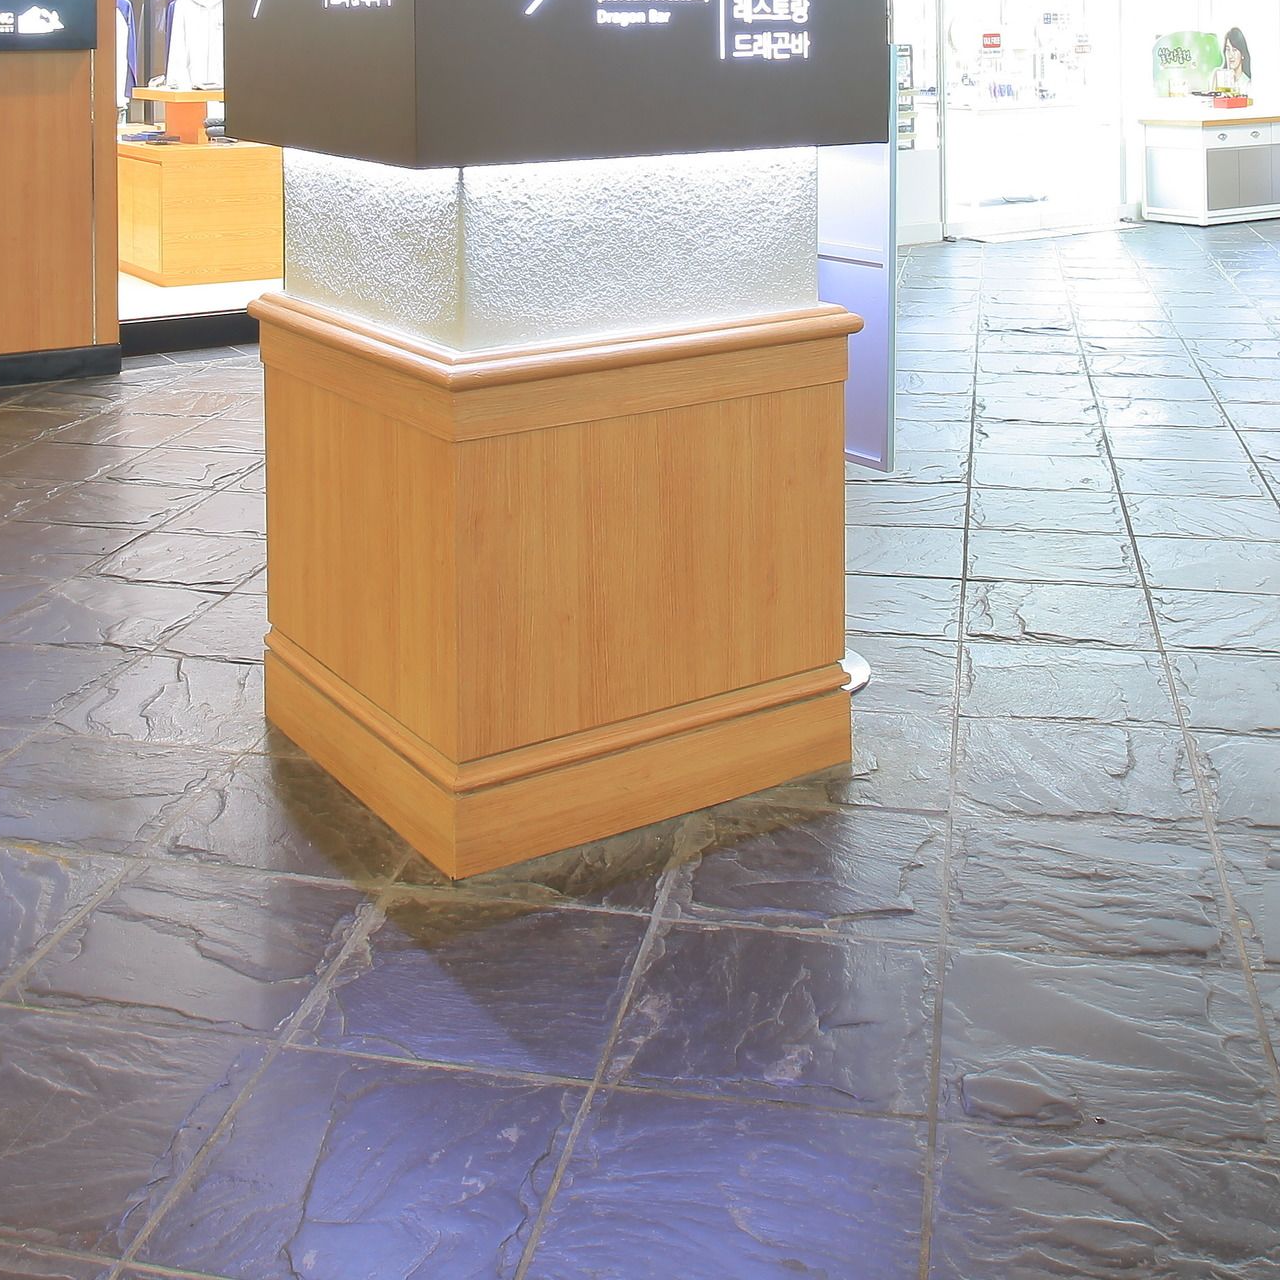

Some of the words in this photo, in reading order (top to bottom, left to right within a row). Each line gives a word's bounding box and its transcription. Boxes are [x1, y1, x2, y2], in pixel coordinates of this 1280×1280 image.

[596, 9, 646, 27] Dragon
[648, 9, 671, 23] Bar
[732, 31, 810, 60] 드래곤바
